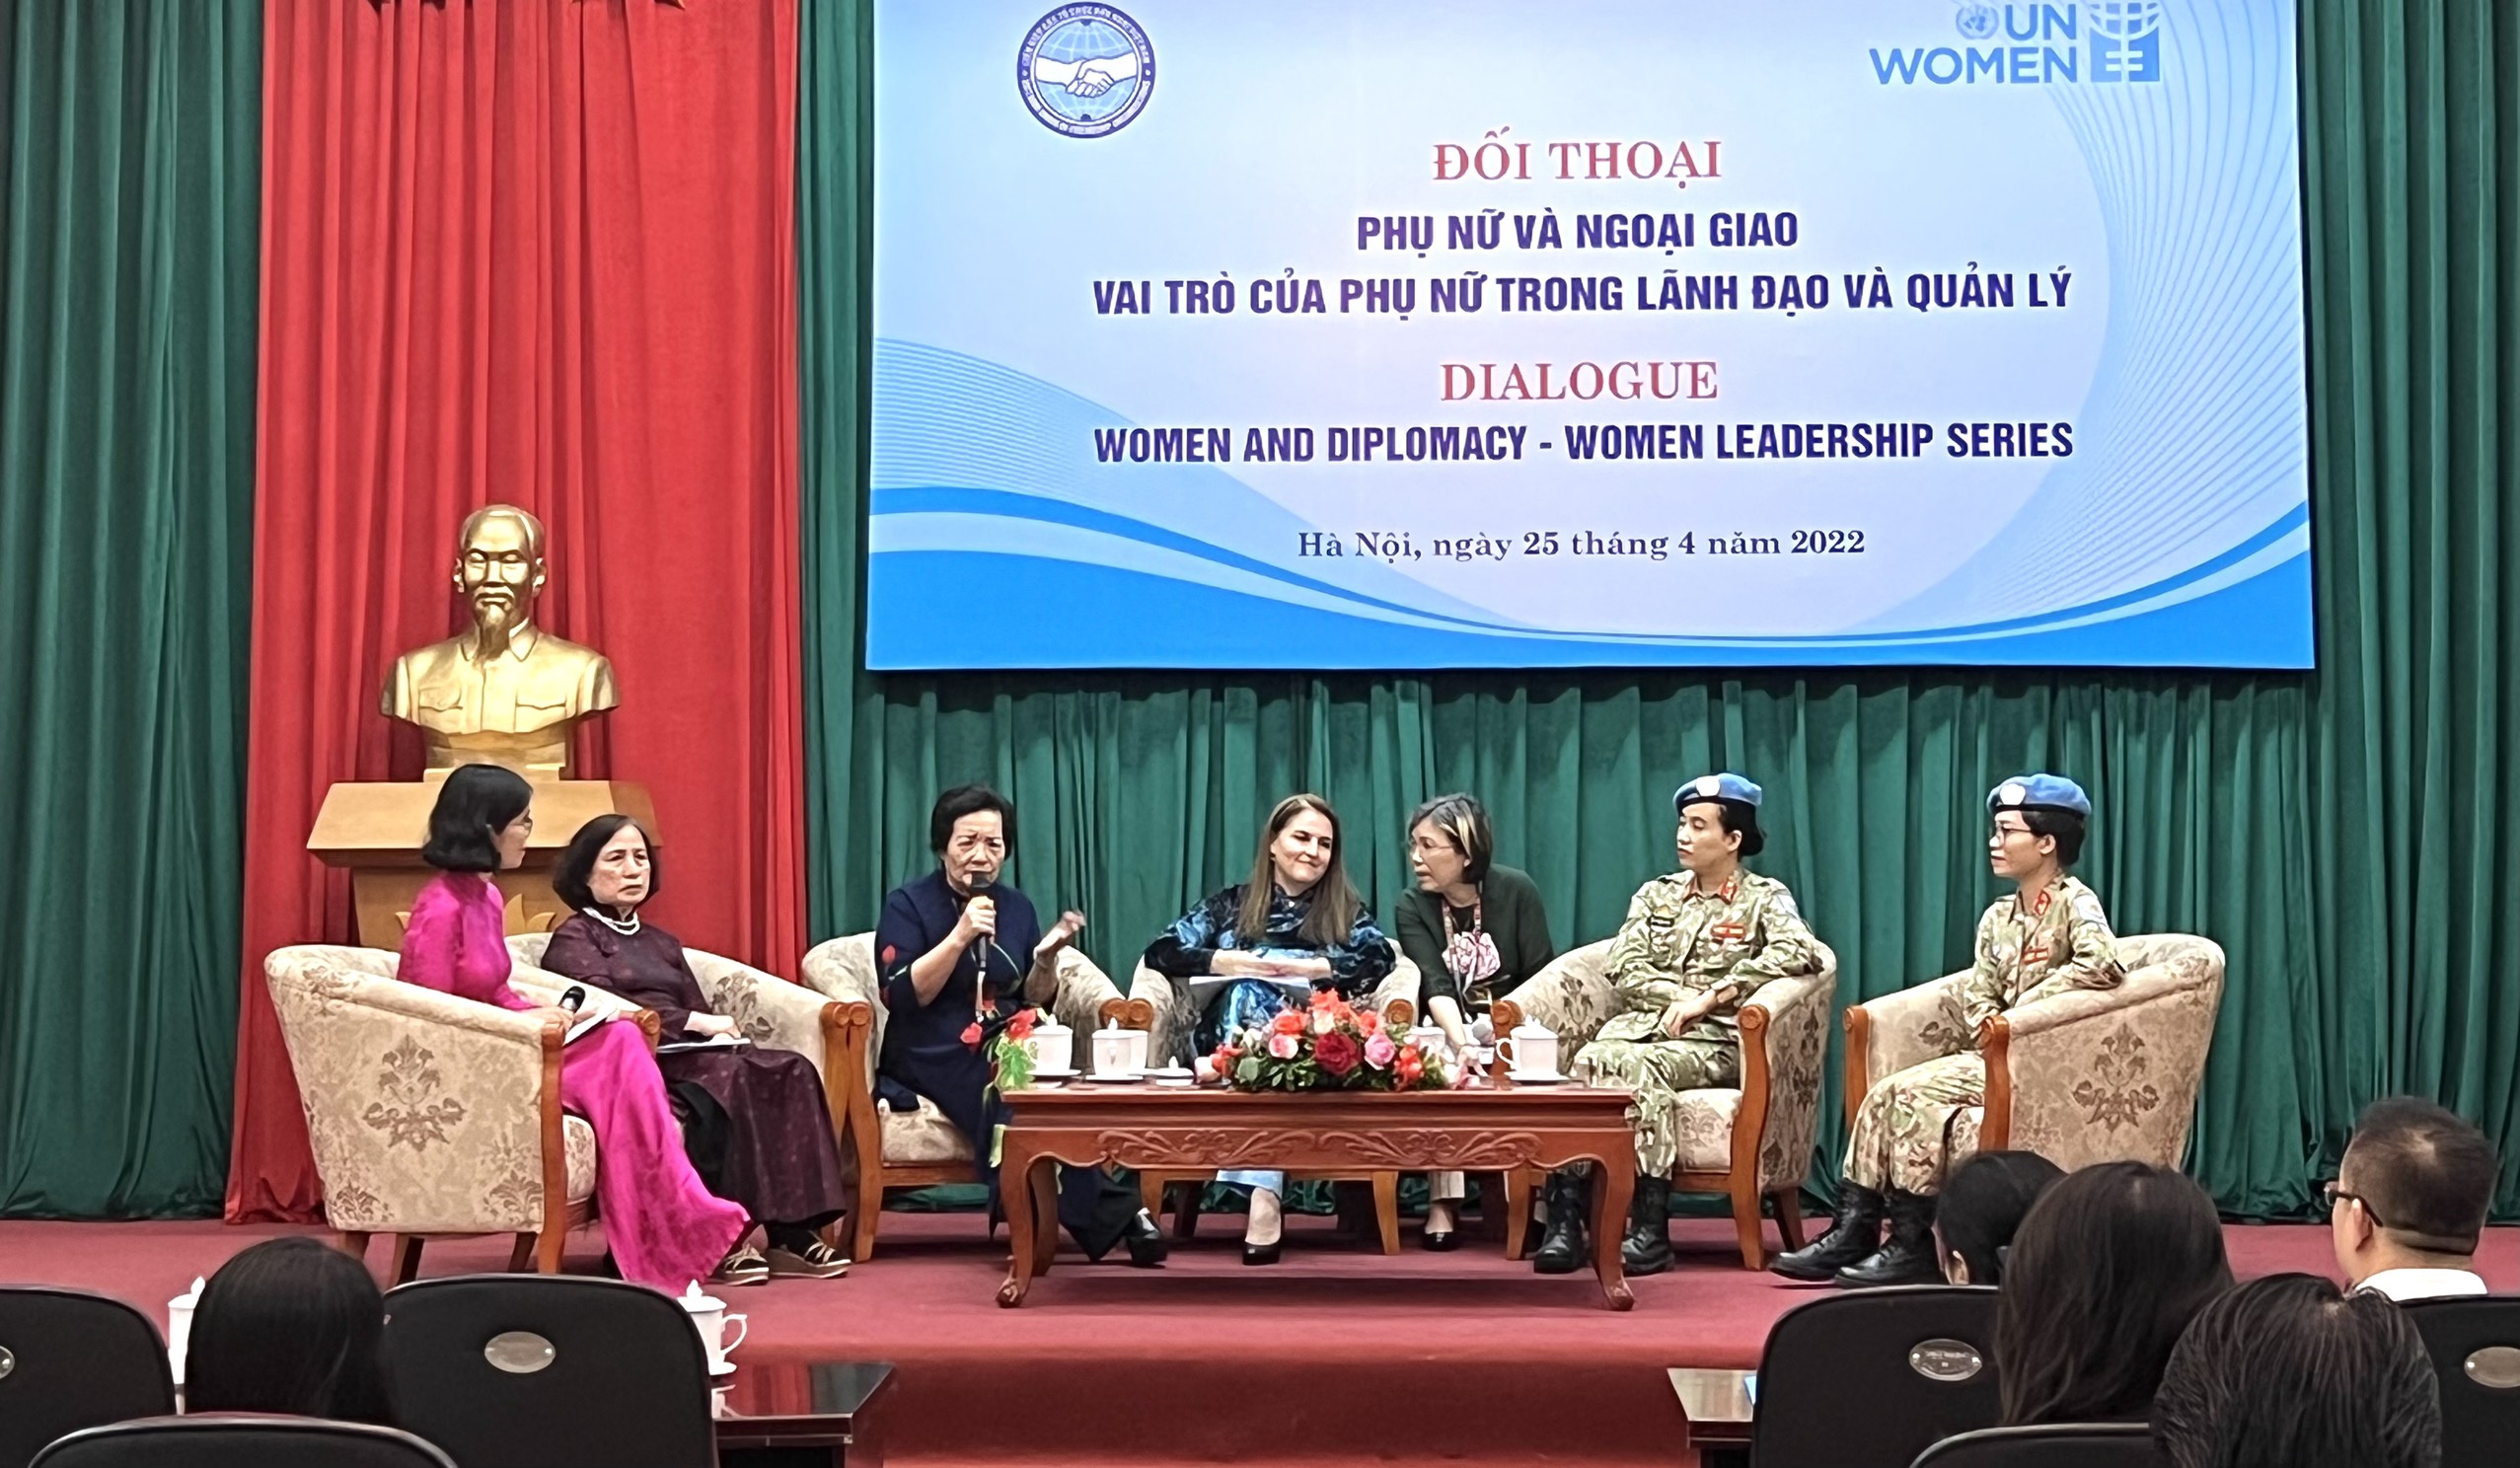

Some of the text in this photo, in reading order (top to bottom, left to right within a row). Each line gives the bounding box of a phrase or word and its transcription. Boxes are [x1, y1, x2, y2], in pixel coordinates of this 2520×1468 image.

[2005, 4, 2077, 40] UN
[1869, 46, 2078, 85] WOMEN
[1434, 126, 1722, 188] ĐỐI THOẠI
[1358, 206, 1798, 258] PHỤ NỮ VÀ NGOẠI GIAO
[1092, 260, 2072, 322] VAI TRÒ CỦA PHỤ NỮ TRONG LÃNH ĐẠO VÀ QUẢN LÝ
[1440, 361, 1718, 402] DIALOGUE
[1093, 427, 1231, 463] WOMEN
[1243, 427, 1314, 463] AND
[1328, 425, 1527, 462] DIPLOMACY
[1564, 424, 1704, 460] WOMEN
[1717, 422, 1934, 460] LEADERSHIP
[1947, 421, 2073, 458] SERIES
[1297, 530, 1865, 564] Hà Nội, ngày 25 tháng 4 năm 2022
